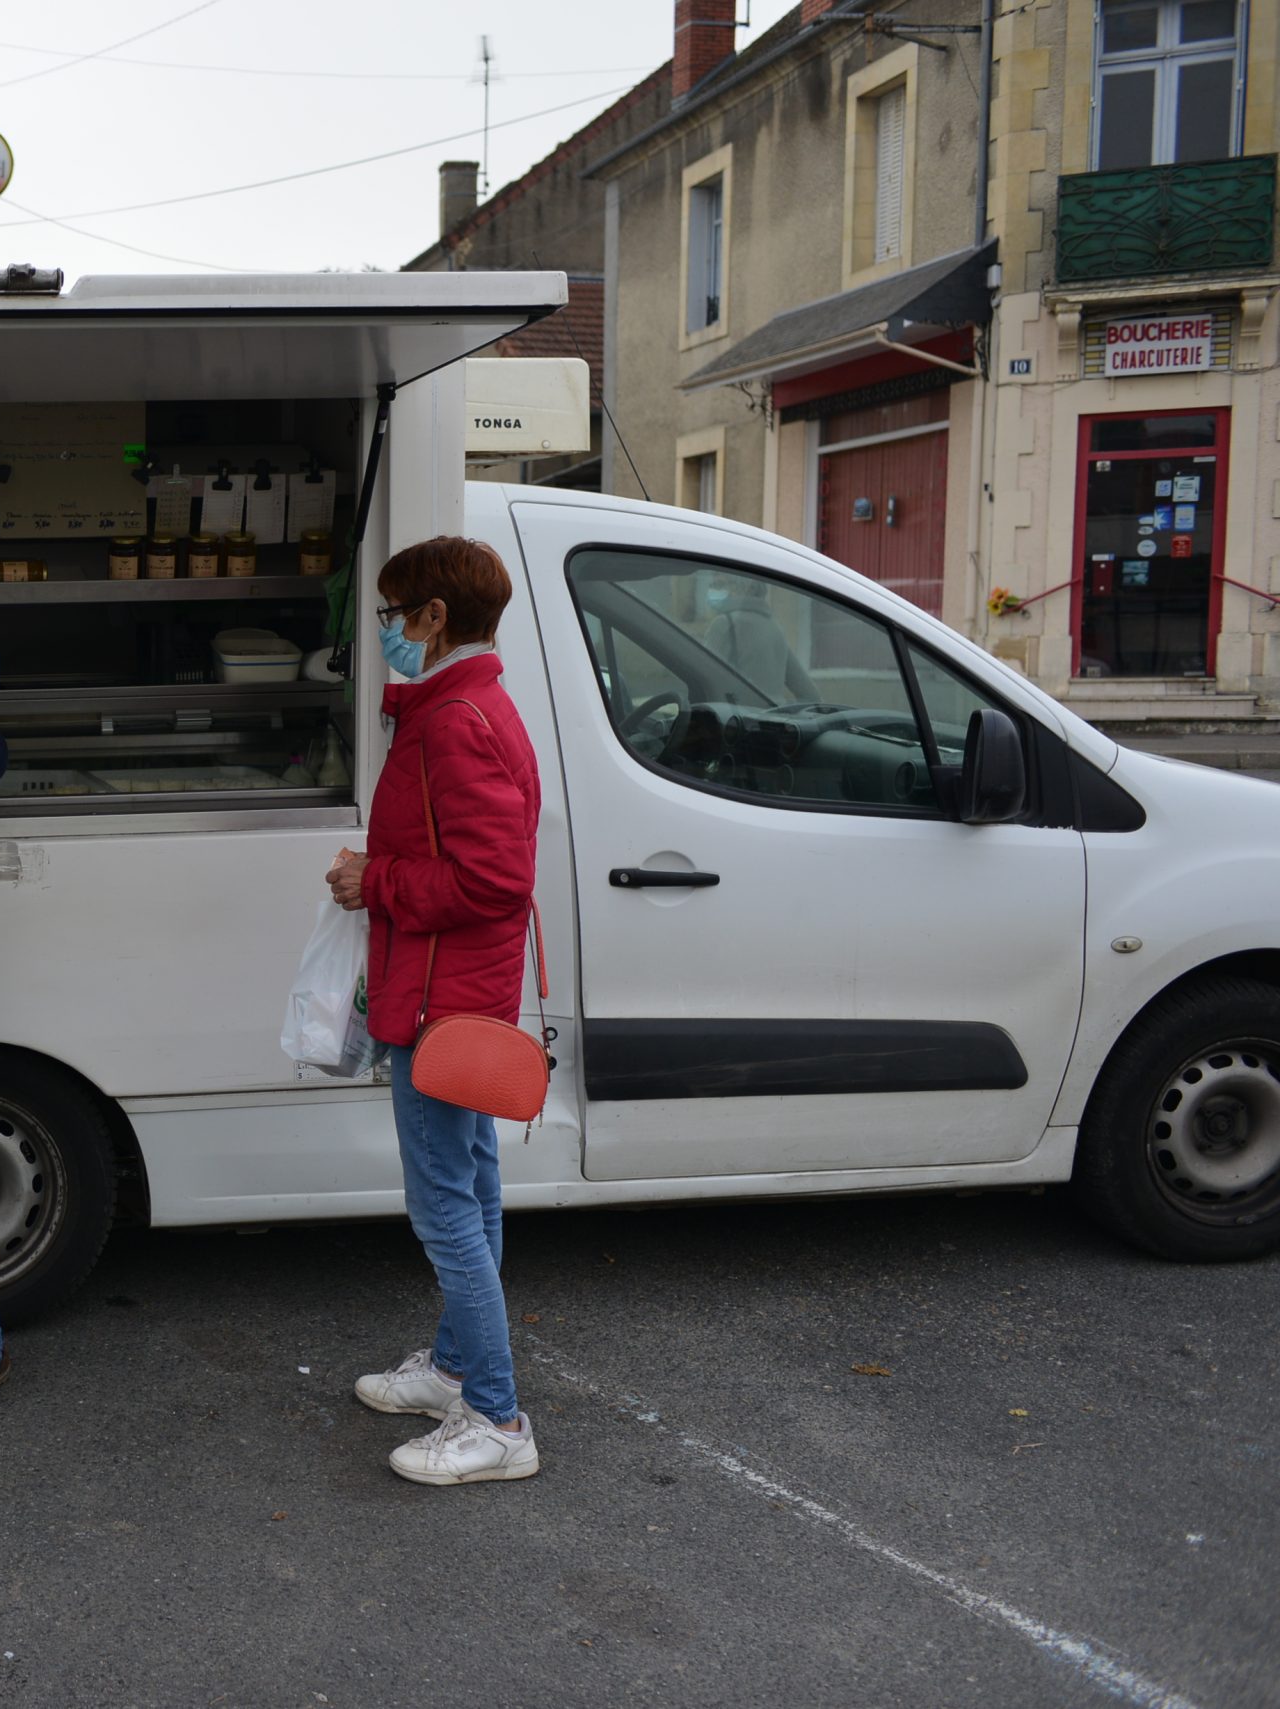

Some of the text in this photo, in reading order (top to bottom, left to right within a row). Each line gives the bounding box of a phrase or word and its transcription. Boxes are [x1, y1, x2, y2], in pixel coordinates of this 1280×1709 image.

[1106, 319, 1211, 345] BOUCHERIE
[1014, 360, 1028, 374] 10
[1112, 346, 1203, 370] CHARCUTERIE
[474, 418, 522, 429] TONGA
